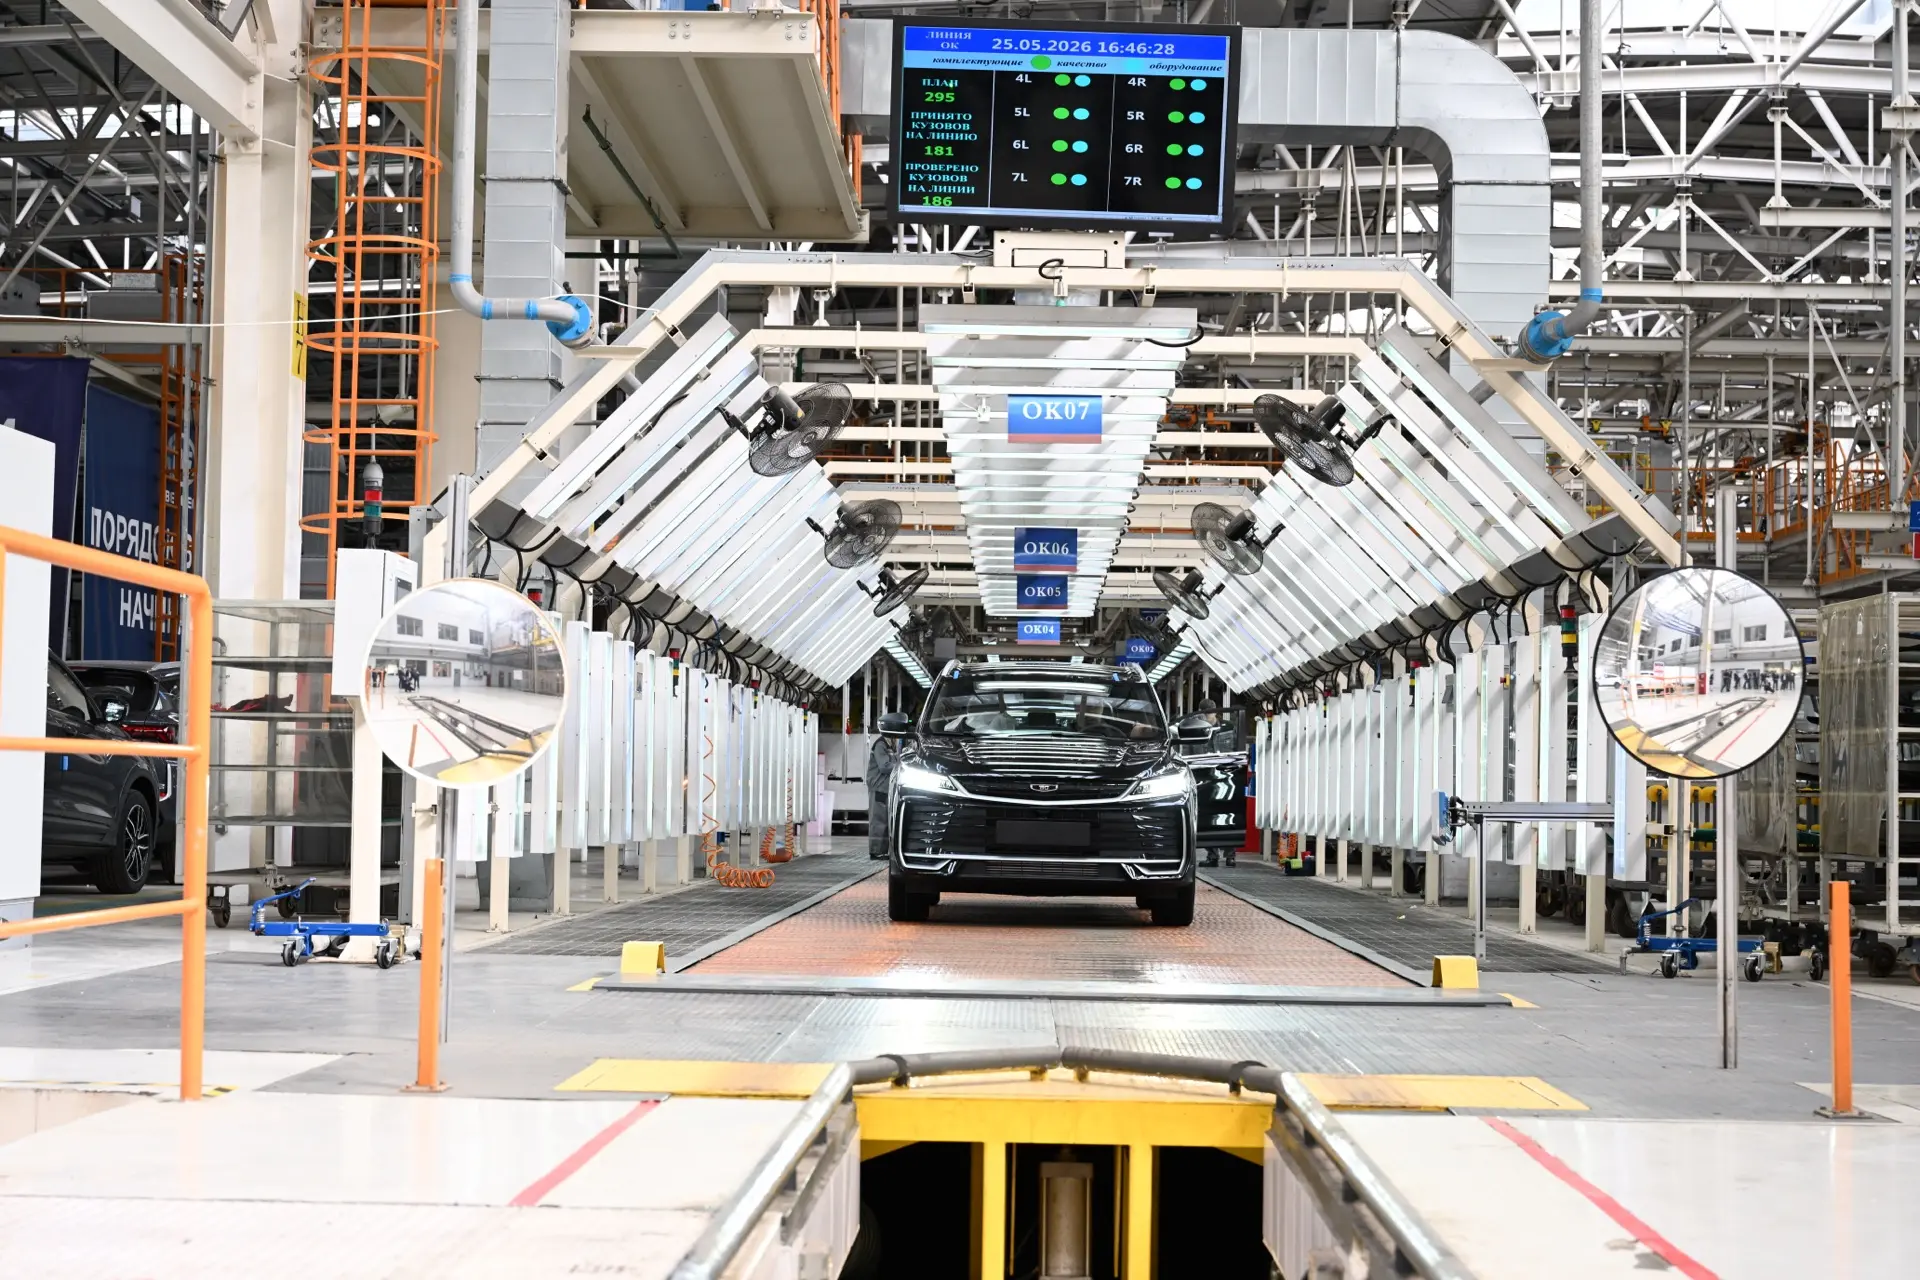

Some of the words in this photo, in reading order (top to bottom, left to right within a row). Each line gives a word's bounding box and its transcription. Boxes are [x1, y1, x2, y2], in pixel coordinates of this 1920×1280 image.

[925, 31, 972, 40] ЛИНИЯ
[991, 38, 1091, 52] 25.05.2026
[1097, 41, 1175, 55] 16:46:28
[932, 56, 1024, 67] комплектующие
[1056, 60, 1107, 69] качество
[1149, 62, 1223, 73] оборудование
[921, 78, 959, 88] ПЛАН
[1015, 74, 1032, 83] 4L
[1127, 77, 1147, 87] 4R
[924, 91, 955, 103] 295
[911, 111, 973, 121] ПРИНЯТО
[1014, 107, 1031, 117] 5L
[1126, 111, 1145, 121] 5R
[911, 121, 970, 131] КУЗОВОВ
[906, 131, 924, 140] НА
[926, 132, 978, 142] ЛИНИЮ
[1012, 140, 1030, 150] 6L
[1125, 144, 1144, 154] 6R
[924, 145, 954, 156] 181
[905, 162, 979, 173] ПРОВЕРЕНО
[909, 173, 968, 182] КУЗОВОВ
[1011, 172, 1028, 182] 7L
[1123, 176, 1143, 186] 7R
[908, 184, 926, 193] НА
[928, 185, 975, 194] ЛИНИИ
[922, 195, 953, 207] 186
[1022, 401, 1090, 420] OK07
[1024, 541, 1069, 555] OK06
[1024, 586, 1061, 597] OK05
[1023, 624, 1055, 634] OK04
[1130, 645, 1155, 653] OK02
